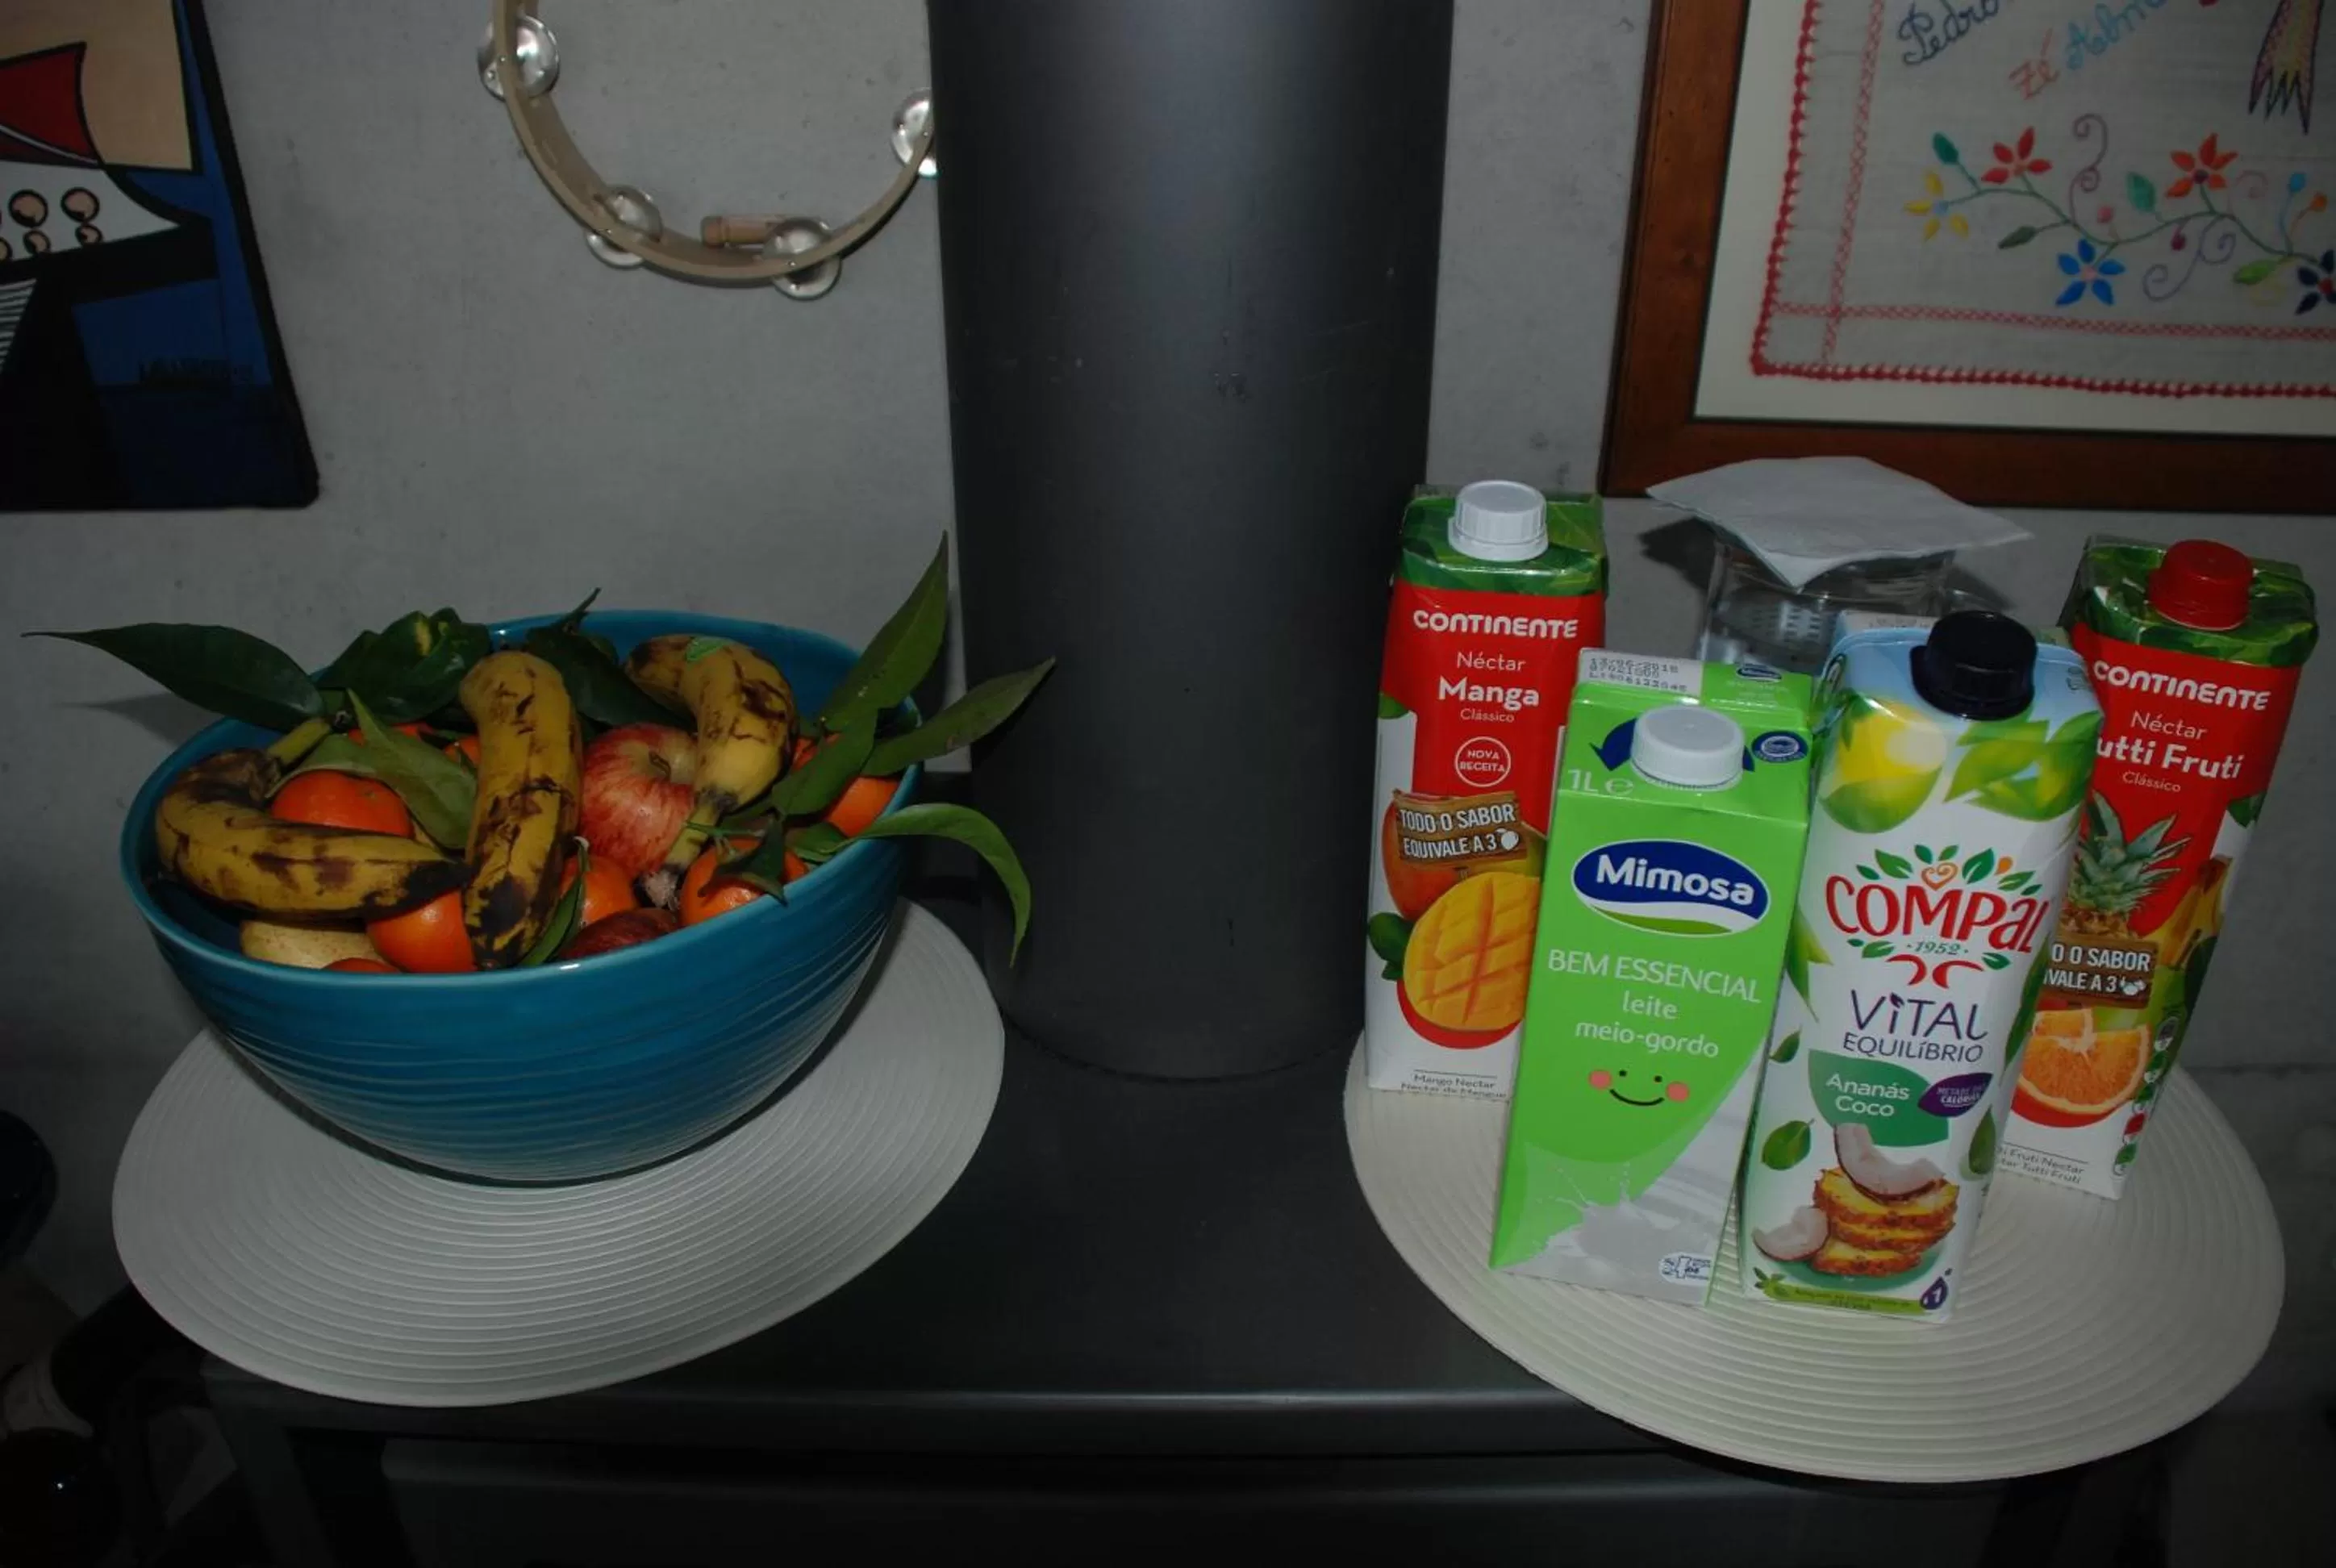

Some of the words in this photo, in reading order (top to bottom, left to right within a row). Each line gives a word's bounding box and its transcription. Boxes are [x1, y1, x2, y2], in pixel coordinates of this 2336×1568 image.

[1413, 609, 1580, 639] CONTINENTE
[1456, 651, 1527, 672] Néctar
[1438, 675, 1540, 711] Manga
[2093, 660, 2271, 711] CONTINENTE
[1459, 707, 1516, 724] Clássico
[2130, 710, 2207, 740] Néctar
[1459, 761, 1506, 774] RECEITA
[1467, 749, 1501, 761] NOVA
[2096, 735, 2157, 766] utti
[2162, 743, 2245, 779] Fruti
[1567, 769, 1599, 793] 1L
[2121, 769, 2182, 793] Clássico
[1400, 808, 1437, 834] TODO
[1441, 812, 1453, 832] O
[1456, 803, 1516, 829] SABOR
[1403, 836, 1471, 859] EQUIVALE
[1474, 836, 1484, 853] A
[1486, 832, 1497, 851] 3
[1596, 853, 1756, 906] Mimosa
[2070, 945, 2083, 965] O
[2086, 947, 2151, 973] SABOR
[1547, 948, 1609, 977] BEM
[1615, 956, 1762, 1003] ESSENCIAL
[2043, 968, 2088, 990] IVALE
[2090, 974, 2102, 992] A
[2106, 974, 2117, 993] 3
[1622, 990, 1679, 1020] leite
[1575, 1020, 1720, 1058] meio-gordo
[1842, 1031, 1984, 1064] EQUILÍBRIO
[1413, 1074, 1453, 1086] Mango
[1455, 1078, 1496, 1089] Nectar
[1825, 1073, 1911, 1101] Ananás
[1834, 1095, 1895, 1118] Coco
